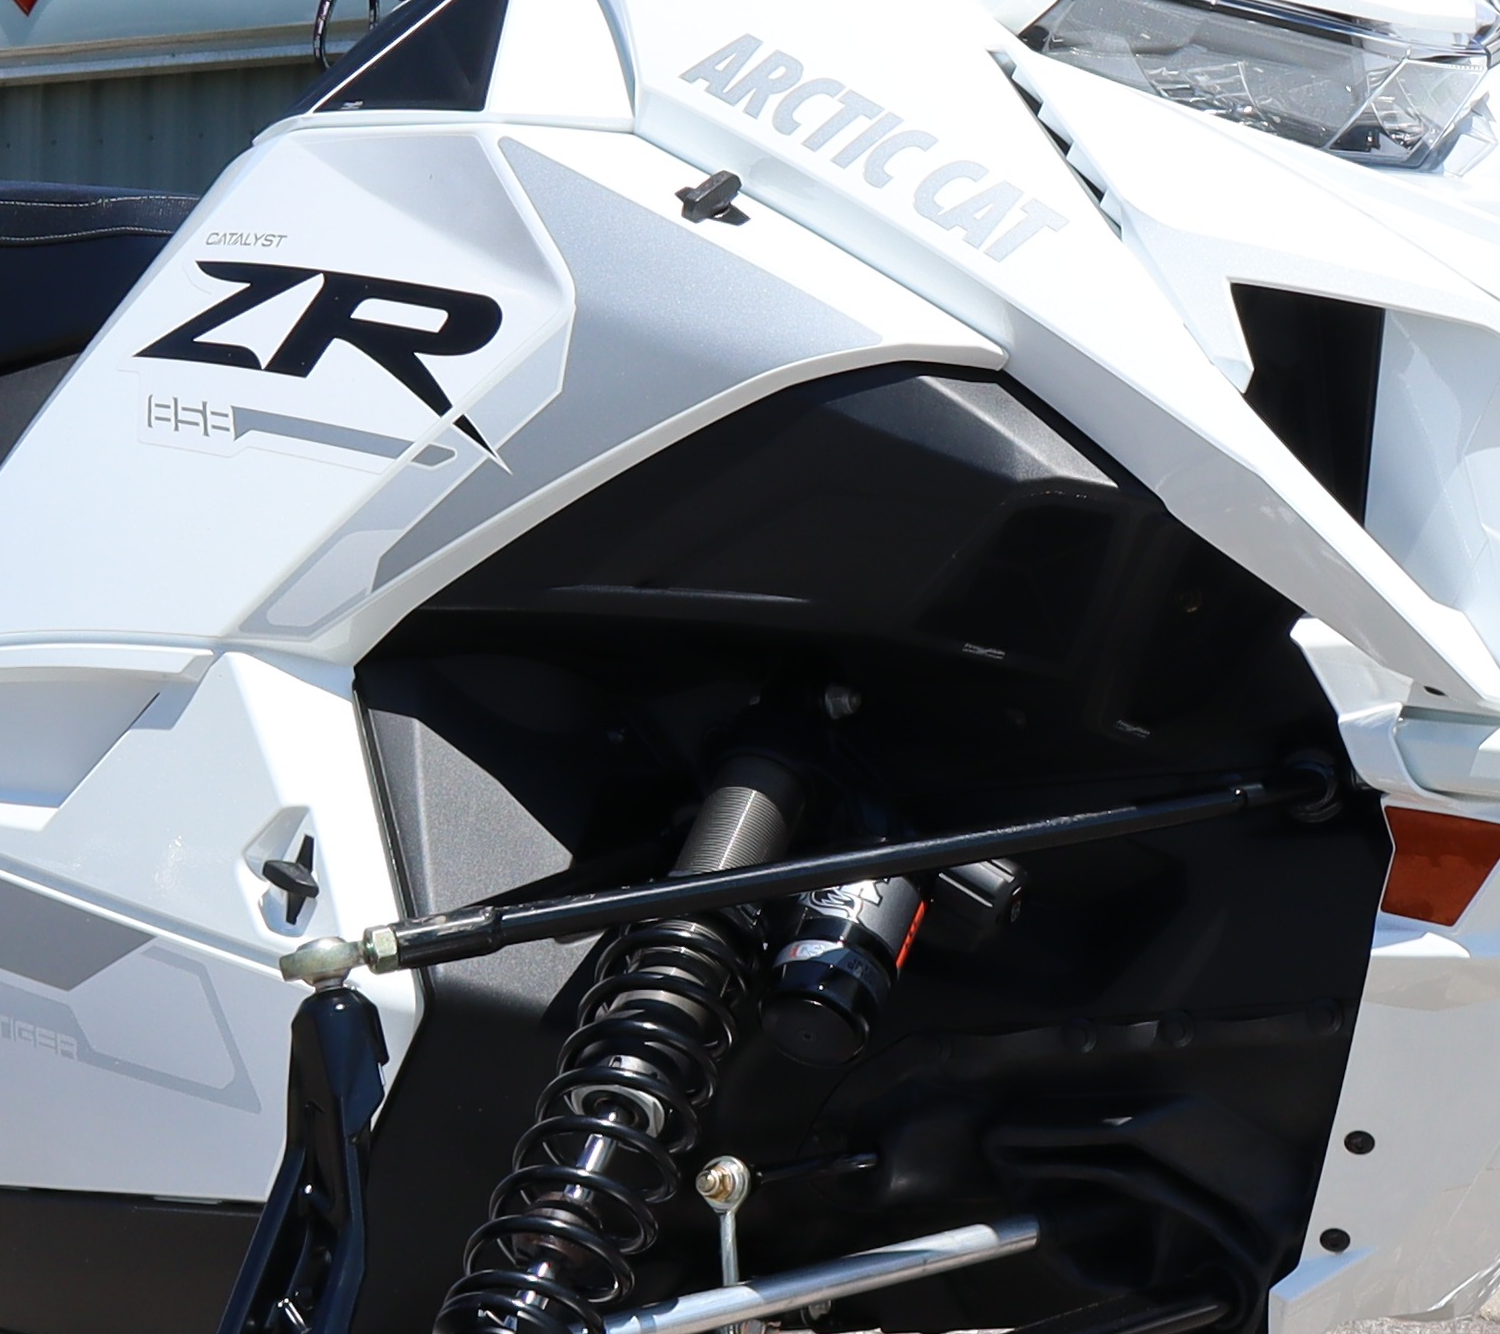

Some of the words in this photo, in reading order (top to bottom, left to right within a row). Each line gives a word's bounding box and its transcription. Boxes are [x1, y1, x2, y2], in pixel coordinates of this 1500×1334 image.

[204, 231, 288, 248] CATALYST
[678, 33, 939, 189] ARCTIC
[912, 160, 1071, 263] CAT
[132, 260, 512, 474] ZR
